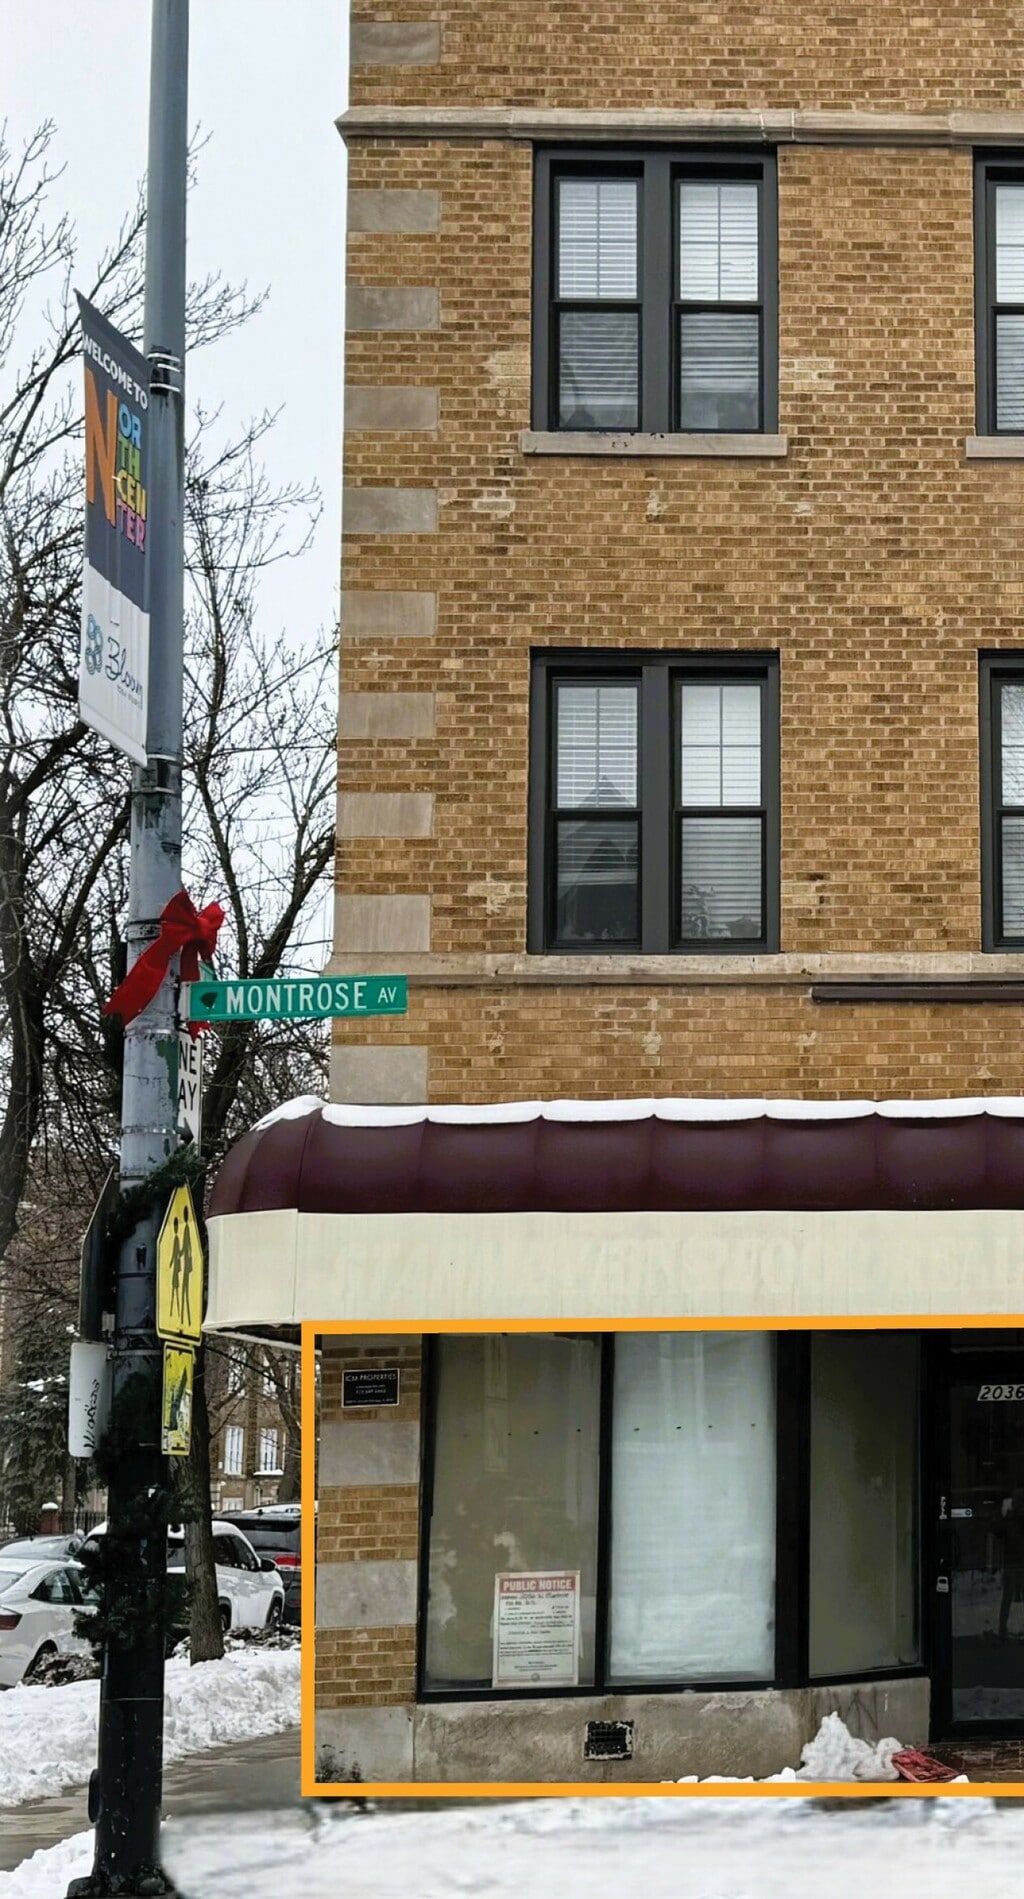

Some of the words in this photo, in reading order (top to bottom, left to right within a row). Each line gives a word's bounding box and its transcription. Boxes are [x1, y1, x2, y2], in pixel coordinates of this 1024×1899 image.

[82, 331, 133, 396] WELCOME
[133, 382, 148, 410] TO
[226, 981, 368, 1014] MONTROSE
[377, 986, 397, 1004] AV
[503, 1581, 536, 1591] PUBLIC
[539, 1579, 572, 1591] NOTICE
